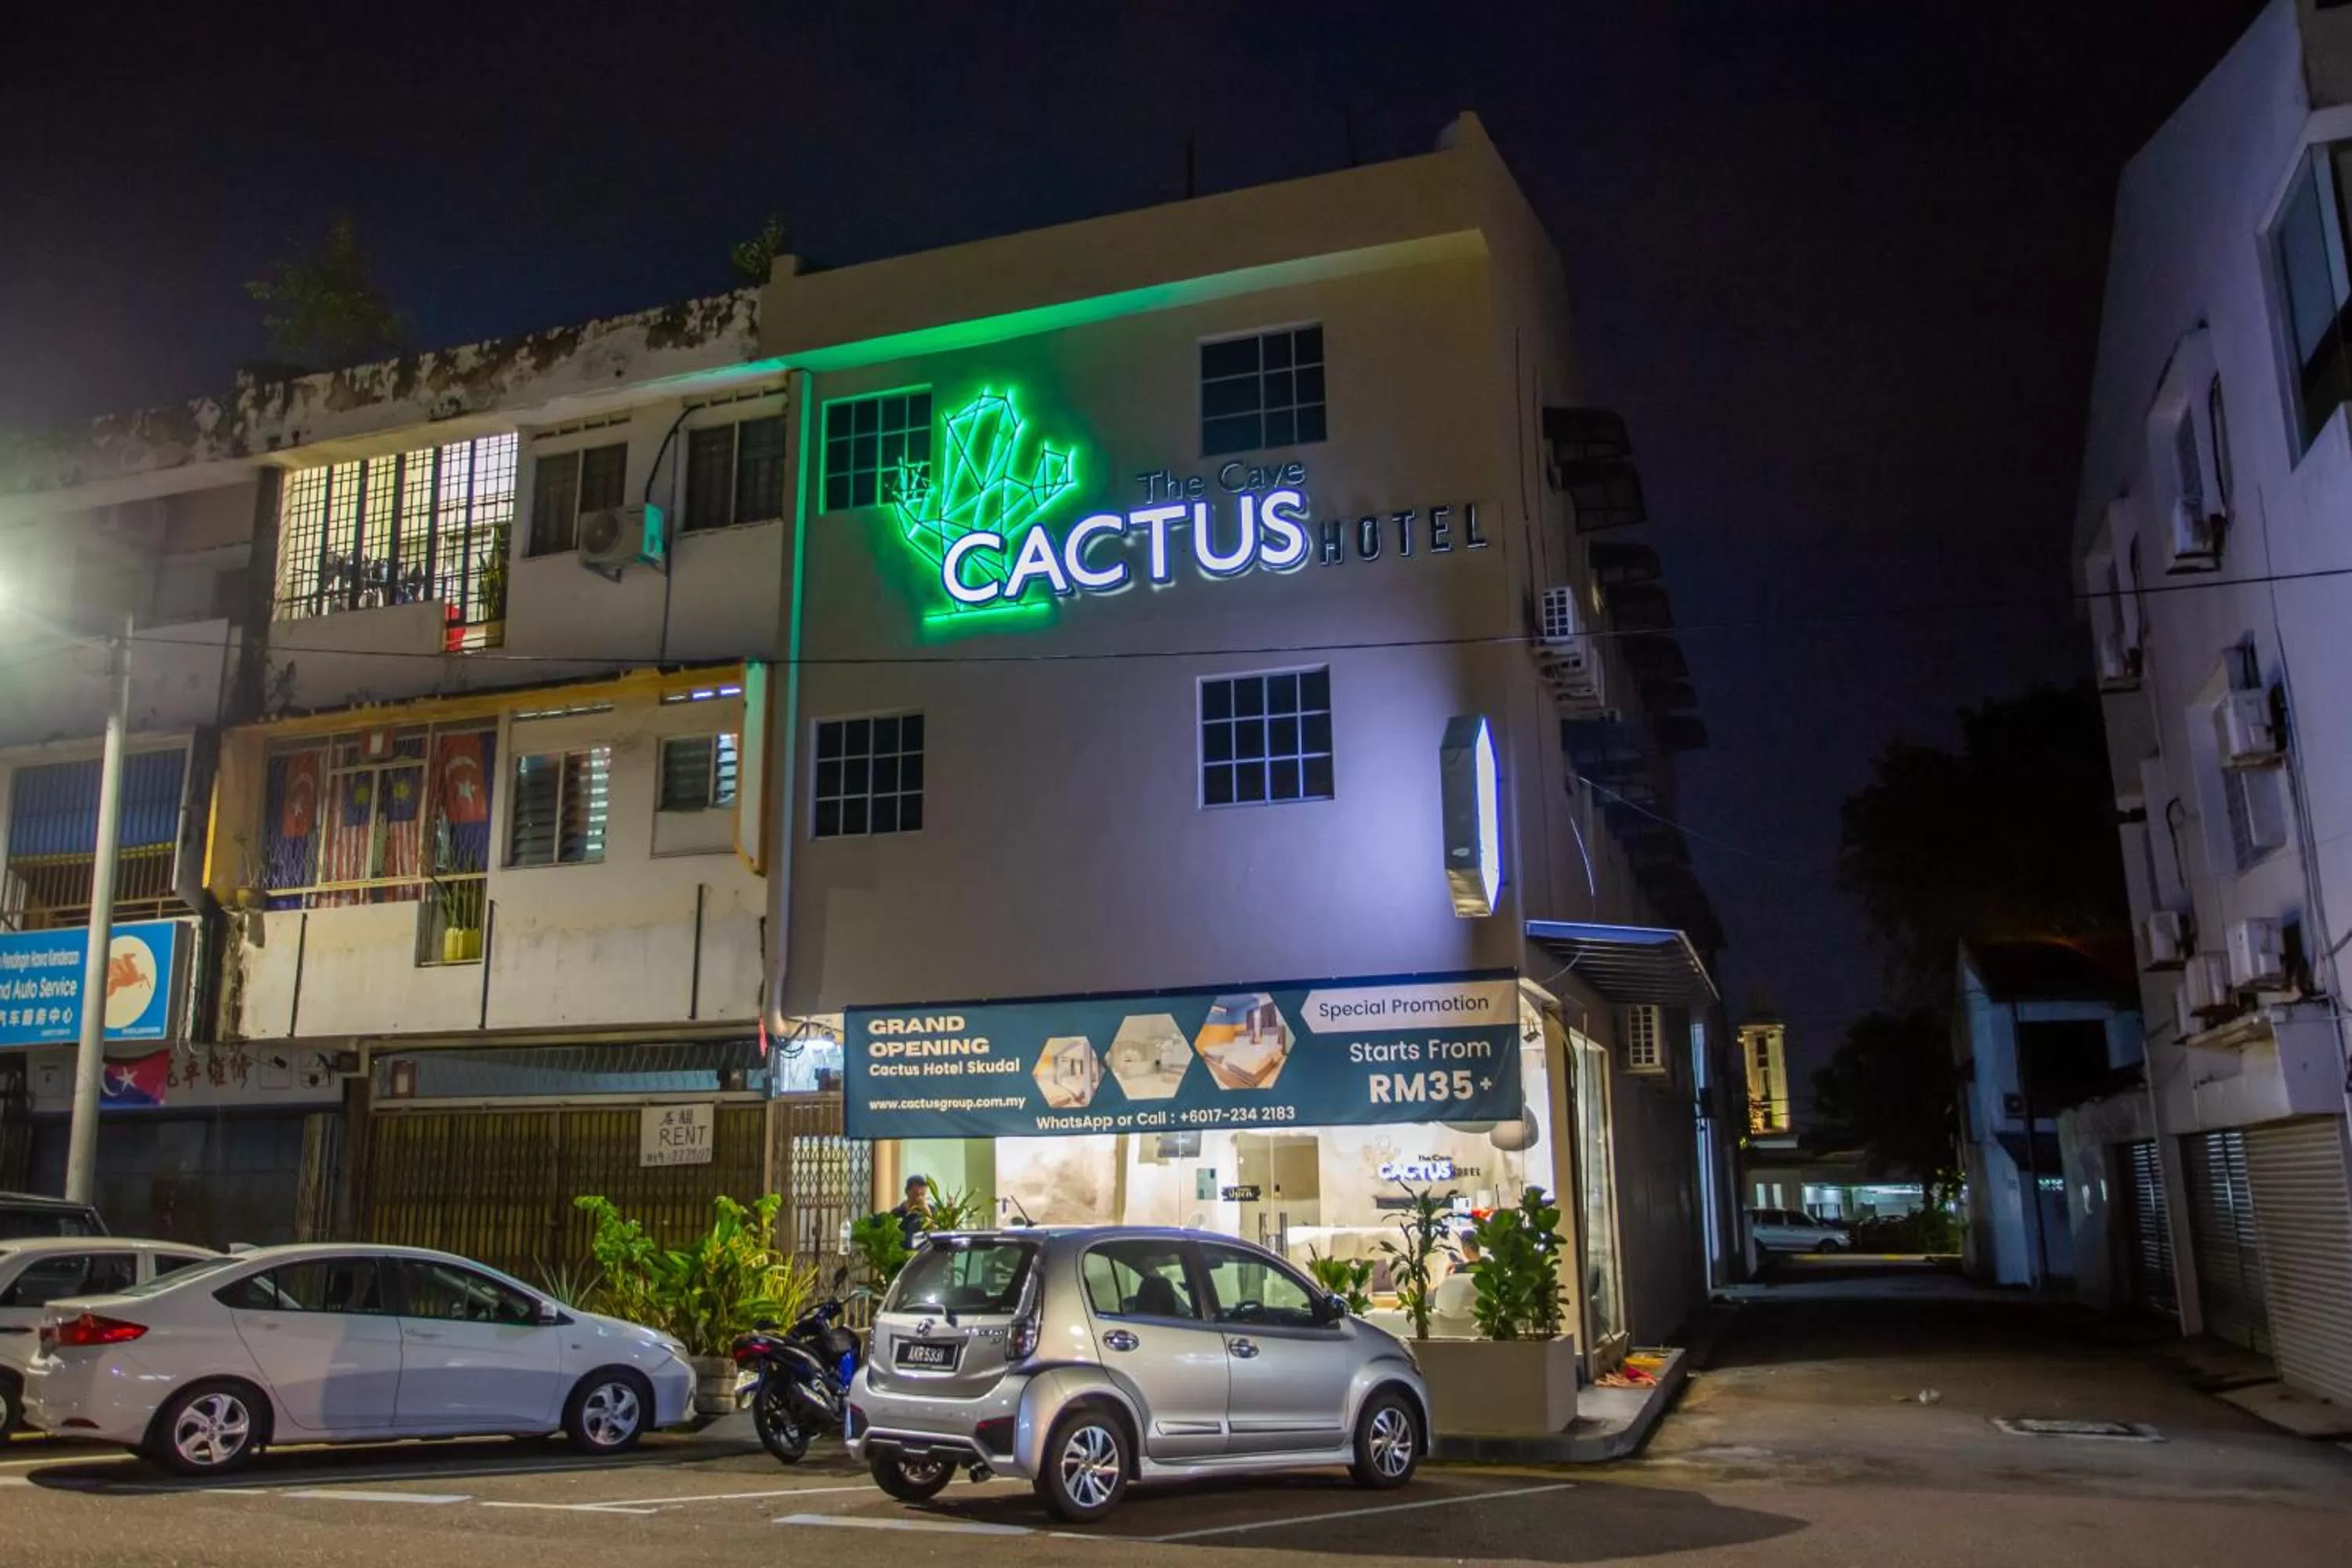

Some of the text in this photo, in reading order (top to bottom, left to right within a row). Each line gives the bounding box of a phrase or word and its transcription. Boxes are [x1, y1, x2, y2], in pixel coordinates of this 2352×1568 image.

[1138, 459, 1307, 505] The Cave
[941, 489, 1312, 604] CACTUS
[1319, 504, 1489, 566] HOTEL
[13, 978, 38, 1000] Auto
[39, 976, 78, 999] Service
[1319, 994, 1490, 1022] Special Promotion
[868, 1016, 966, 1036] GRAND
[869, 1037, 990, 1058] OPENING
[1349, 1039, 1492, 1063] Starts From
[869, 1063, 920, 1077] Cactus
[924, 1060, 964, 1076] Hotel
[869, 1096, 1026, 1112] www.cactusgroup.com.my
[1036, 1114, 1113, 1131] WhatsApp
[1117, 1115, 1133, 1127] or
[1136, 1112, 1166, 1125] Call
[1180, 1107, 1257, 1123] +6017-234
[1261, 1105, 1296, 1120] 2183
[659, 1126, 709, 1146] RENT
[1379, 1162, 1454, 1181] CACTUS
